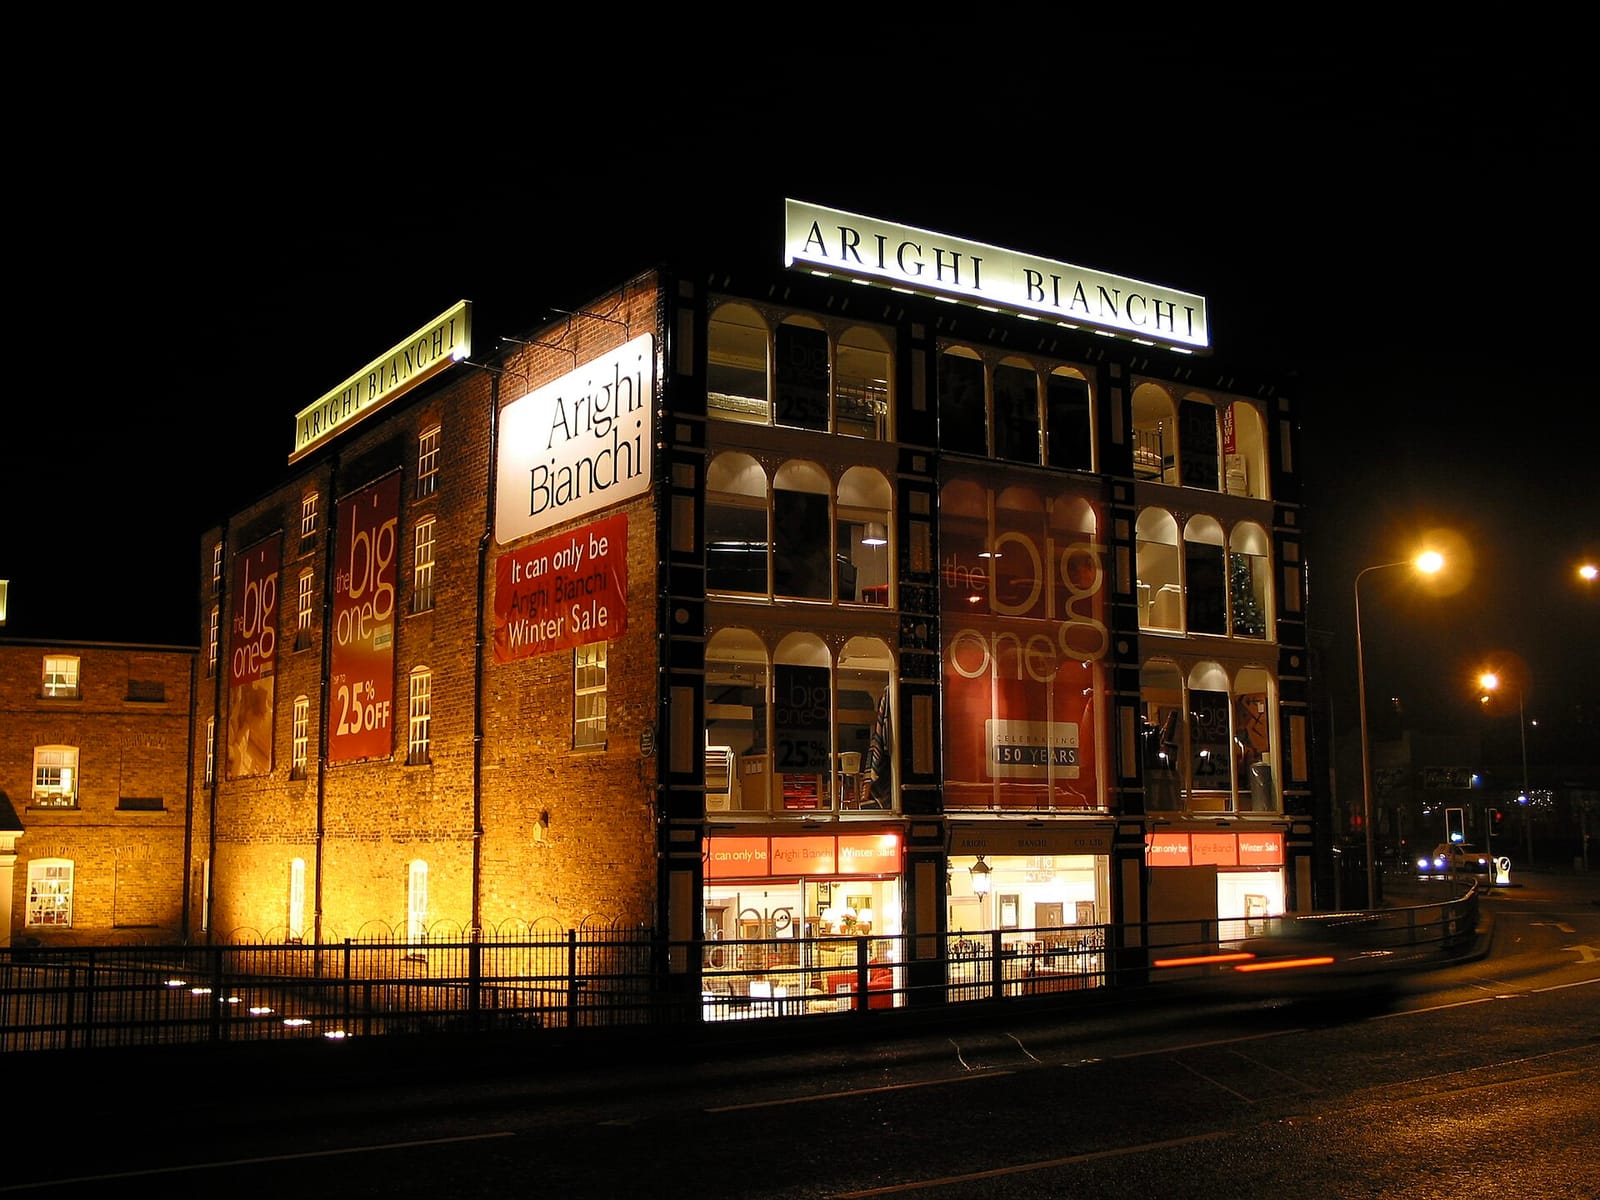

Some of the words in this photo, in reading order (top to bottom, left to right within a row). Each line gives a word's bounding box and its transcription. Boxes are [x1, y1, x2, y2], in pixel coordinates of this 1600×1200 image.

[802, 220, 983, 290] ARIGHI
[1023, 268, 1195, 337] BIANCHI
[302, 382, 361, 444] ARIGHI
[368, 319, 456, 401] BIANCHI
[547, 354, 644, 450] Arighi
[528, 420, 643, 517] Bianchi
[336, 568, 350, 594] the
[349, 493, 398, 621] big
[511, 560, 521, 584] It
[525, 555, 548, 580] can
[553, 538, 584, 572] only
[589, 533, 608, 560] be
[242, 550, 278, 659] big
[511, 584, 549, 619] Arighi
[554, 567, 608, 604] Bianchi
[944, 553, 986, 590] the
[989, 530, 1109, 662] big
[338, 601, 373, 647] one
[508, 616, 564, 648] Winter
[571, 599, 609, 634] Sale
[234, 642, 260, 679] one
[951, 628, 1057, 683] one
[364, 701, 390, 731] OFF
[790, 674, 828, 719] big
[996, 748, 1021, 761] 150
[1031, 749, 1075, 763] YEARS
[714, 851, 731, 860] can
[733, 849, 752, 863] only
[755, 848, 767, 860] be
[774, 848, 800, 862] Arighi
[802, 848, 833, 858] Bianchi
[841, 847, 873, 857] Winter
[1152, 845, 1163, 853] can
[1163, 843, 1177, 855] only
[1178, 843, 1187, 853] be
[1240, 842, 1263, 853] Winter
[1265, 841, 1279, 852] Sale
